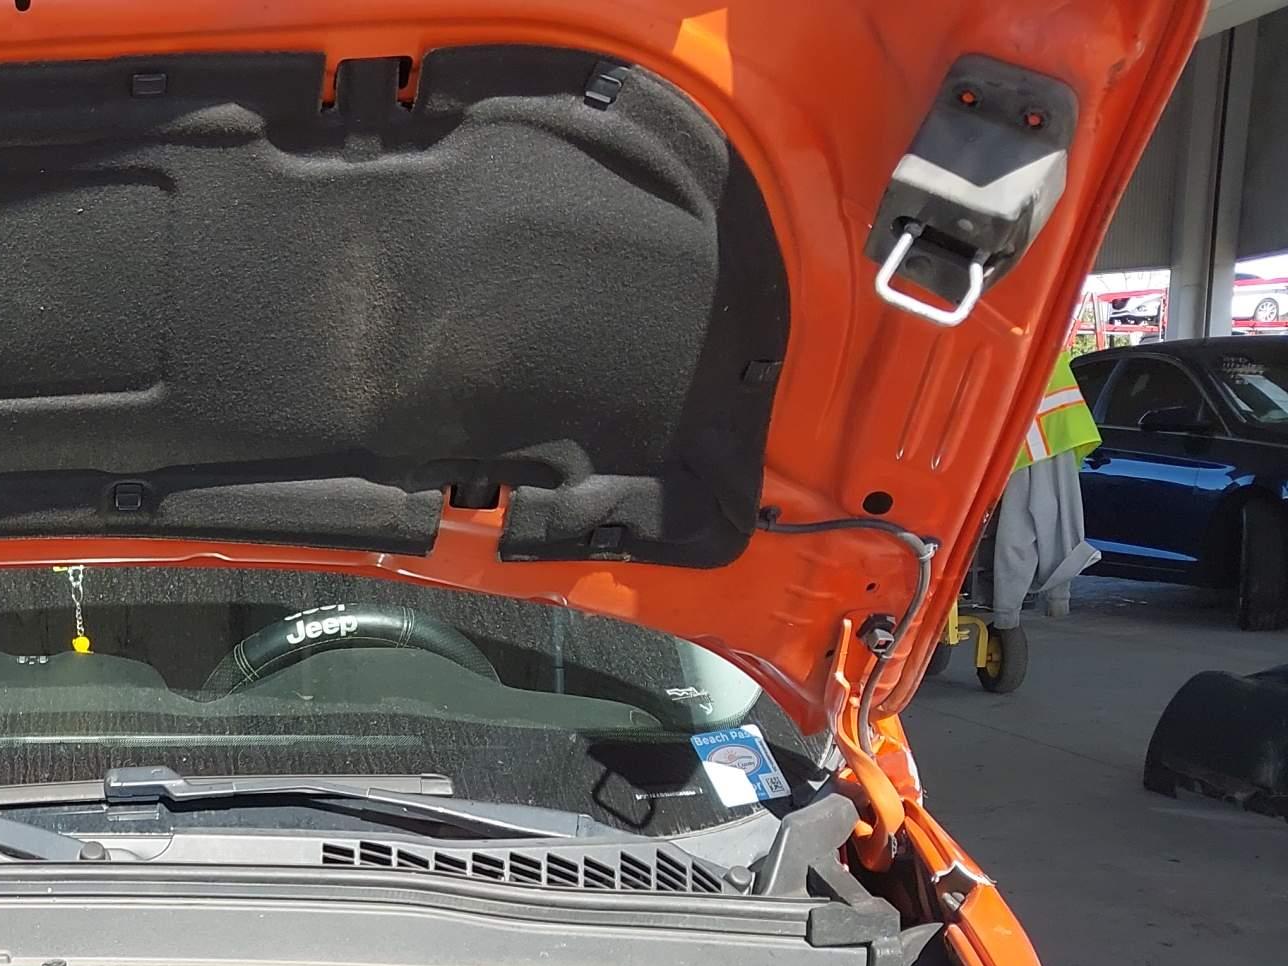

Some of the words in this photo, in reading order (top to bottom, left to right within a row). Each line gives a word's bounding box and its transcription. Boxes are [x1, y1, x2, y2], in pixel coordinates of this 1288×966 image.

[286, 614, 359, 645] Jeep
[694, 731, 730, 746] Beach
[729, 730, 754, 744] Pas
